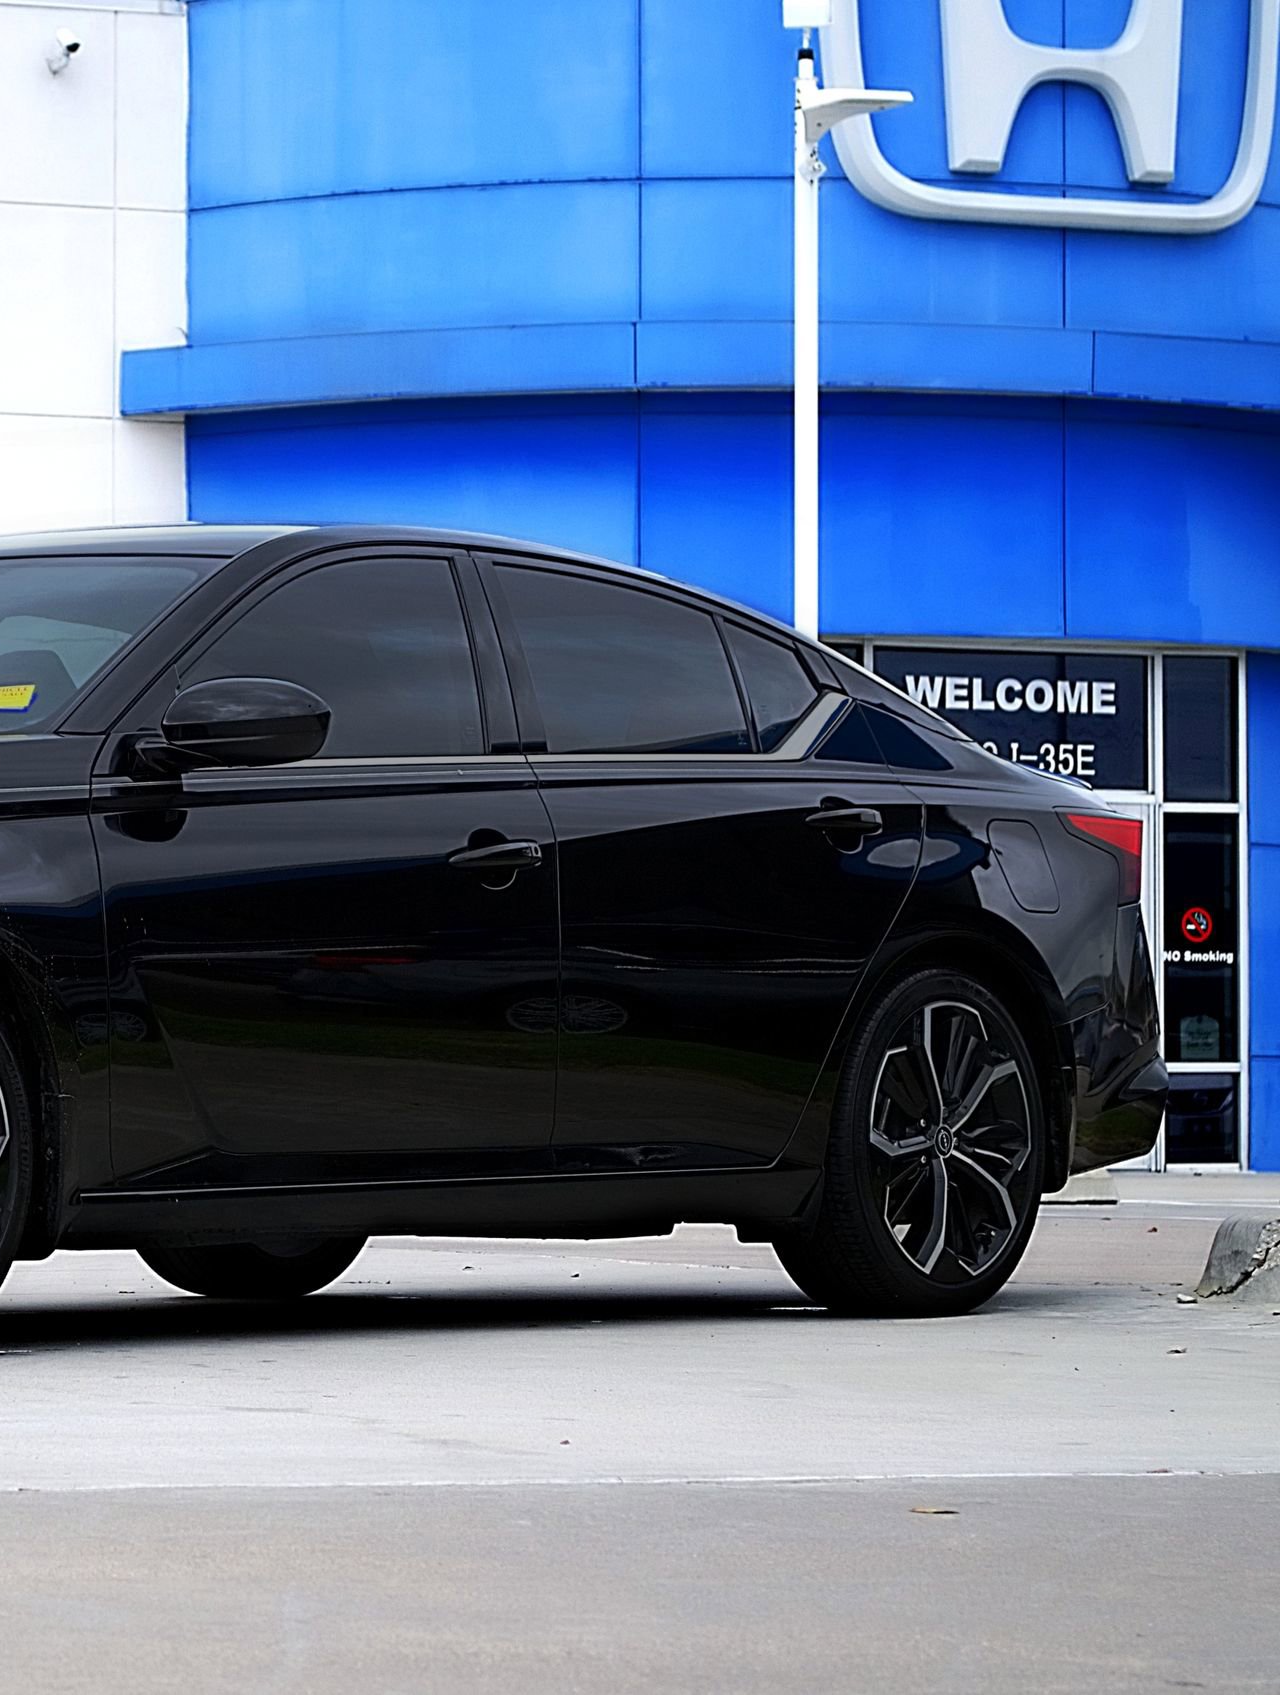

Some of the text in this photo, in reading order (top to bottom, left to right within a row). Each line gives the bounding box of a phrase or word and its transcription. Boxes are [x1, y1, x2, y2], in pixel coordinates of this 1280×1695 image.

[905, 675, 1117, 715] WELCOME
[1163, 950, 1234, 964] NO Smoking
